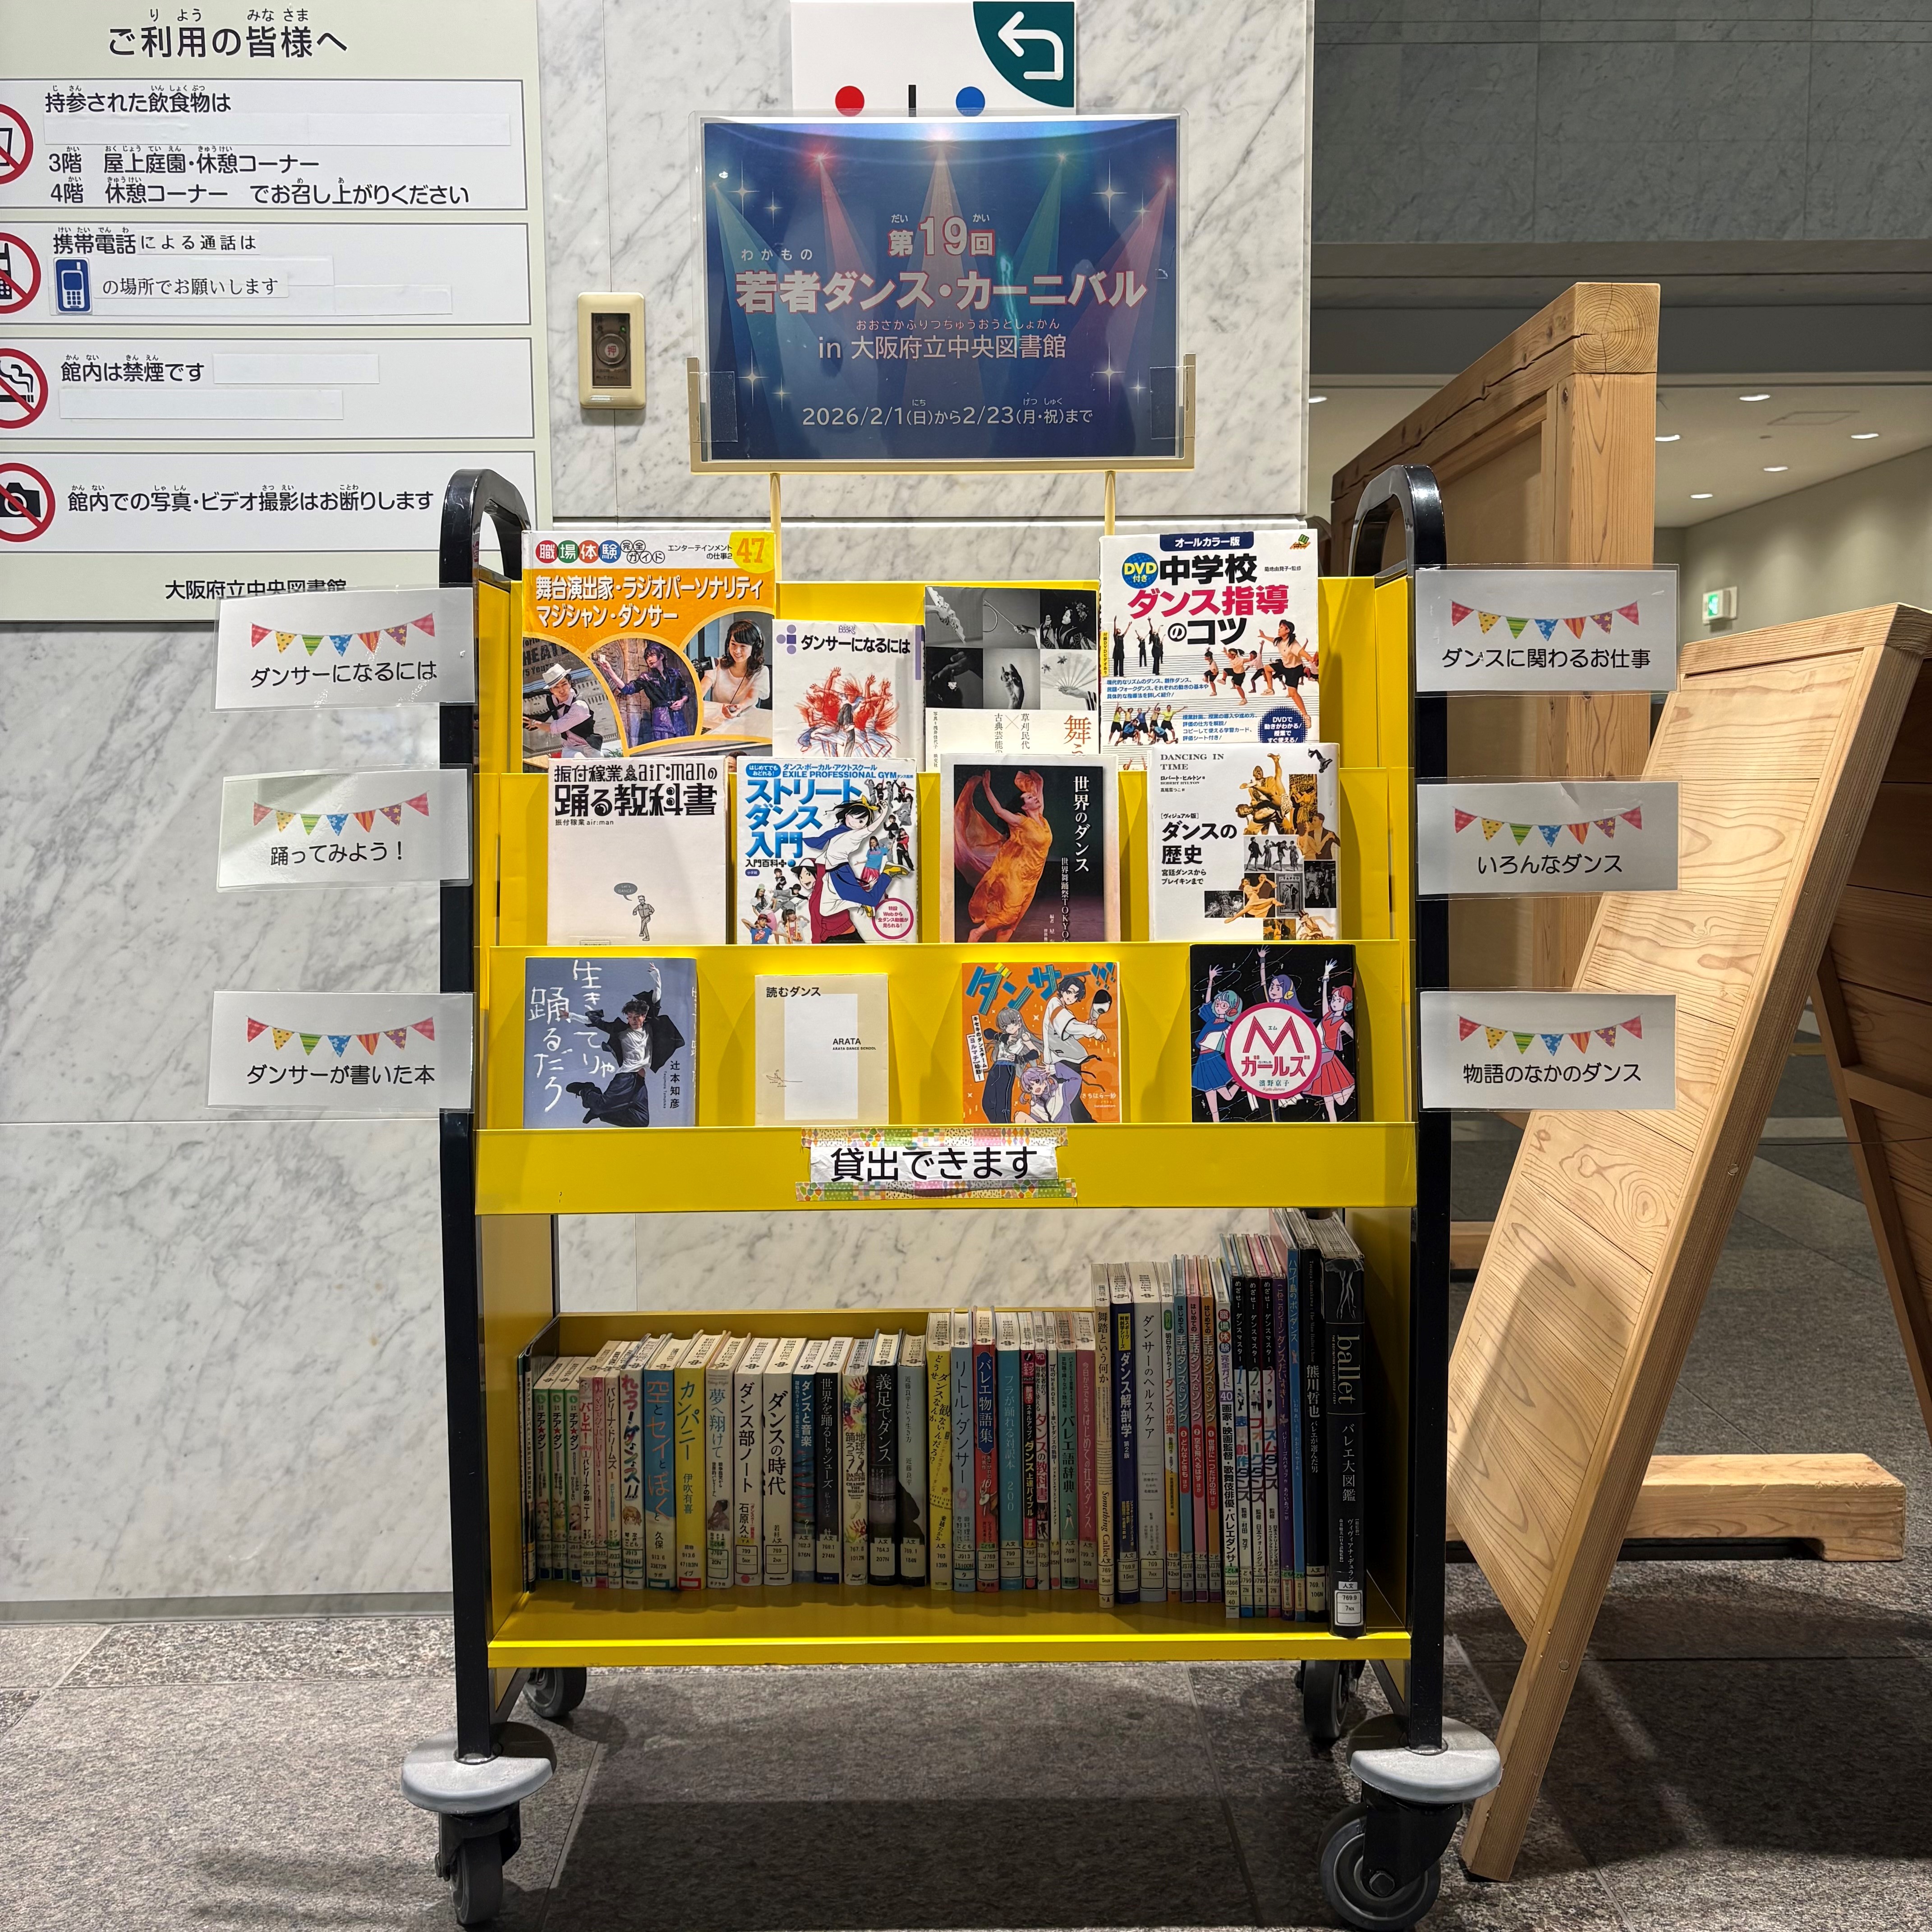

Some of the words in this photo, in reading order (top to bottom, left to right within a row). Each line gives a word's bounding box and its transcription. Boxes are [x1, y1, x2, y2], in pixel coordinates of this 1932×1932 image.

[149, 8, 160, 23] り
[175, 8, 203, 23] よう
[246, 9, 275, 22] みな
[282, 9, 309, 22] さま
[108, 26, 349, 59] ご利用の皆様へ
[44, 91, 232, 113] 持参された飲食物は
[48, 152, 83, 174] 3階
[103, 152, 320, 174] 屋上庭園・休憩コーナー
[50, 183, 84, 205] 4階
[105, 183, 228, 205] 休憩コーナー
[253, 183, 469, 206] でお召し上がりください
[891, 214, 908, 223] だい
[972, 213, 990, 222] かい
[52, 233, 256, 254] 携帯電話による通話は
[888, 215, 994, 257] 第19回
[102, 277, 278, 297] の場所でお願いします
[735, 271, 1147, 314] 若者ダンス・カーニバル
[856, 319, 1060, 331] おおさかふりつちゅうおうとしょかん
[607, 345, 616, 355] 押
[819, 336, 842, 359] in
[851, 334, 1066, 359] 大阪府立中央図書館
[61, 361, 205, 383] 館内は禁煙です
[912, 399, 926, 407] にち
[68, 490, 434, 512] 館内での写真・ビデオ撮影はお断りします
[538, 543, 618, 561] 職場体験
[621, 540, 646, 552] 完全
[736, 538, 764, 564] 47
[1175, 536, 1240, 547] オールカラー版
[627, 551, 665, 563] ガイド
[1124, 563, 1157, 576] DVD
[1159, 553, 1257, 585] 中学校
[535, 575, 763, 601] 舞台演出家・ラジオパーソナリティ
[1127, 585, 1289, 619] ダンス指導
[536, 605, 678, 628] マジシャン・ダンサー
[801, 635, 911, 654] ダンサーになるには
[1168, 618, 1247, 645] のコツ
[1442, 648, 1651, 669] ダンスに関わるお仕事
[250, 661, 436, 689] ダンサーになるには
[1021, 713, 1030, 750] 草刈民代
[554, 765, 623, 782] 振付稼業
[555, 782, 717, 816] 踊る教科書
[745, 779, 862, 805] ストリート
[745, 803, 823, 831] ダンス
[1072, 776, 1090, 872] 世界のダンス
[745, 832, 803, 858] 入門
[1161, 822, 1237, 842] ダンスの
[270, 841, 404, 867] 踊ってみよう！
[1161, 844, 1203, 865] 歴史
[1478, 854, 1623, 874] いろんなダンス
[766, 986, 821, 998] 読むダンス
[1242, 1015, 1305, 1055] M
[528, 986, 573, 1113] 踊るだろ
[247, 1065, 436, 1086] ダンサーが書いた本
[1241, 1055, 1310, 1077] ガールズ
[1463, 1063, 1642, 1084] 物語のなかのダンス
[670, 1060, 681, 1109] 辻本知彦
[830, 1147, 1037, 1182] 貸出できます
[1219, 1309, 1231, 1353] 職場体験
[1098, 1312, 1109, 1383] 舞踏という何か
[1142, 1315, 1155, 1439] ダンサーのヘルスケア
[1337, 1334, 1361, 1405] ballet
[979, 1360, 993, 1443] バレエ物語集
[1120, 1352, 1132, 1437] ダンス解剖学
[1307, 1365, 1320, 1418] 熊川哲也
[801, 1381, 812, 1447] ダンスと音楽
[876, 1374, 892, 1463] 義足でダンス
[1164, 1378, 1175, 1434] ダンスの授業
[677, 1381, 699, 1460] カンパニー
[709, 1388, 726, 1458] 夢へ翔けて
[955, 1361, 970, 1483] リトル・ダンサー
[739, 1382, 754, 1492] ダンス部ノート
[768, 1391, 788, 1495] ダンスの時代
[1062, 1416, 1075, 1492] バレエ語辞典
[1342, 1424, 1356, 1502] バレエ大図鑑
[683, 1473, 693, 1514] 伊吹有喜
[1101, 1491, 1109, 1531] Something
